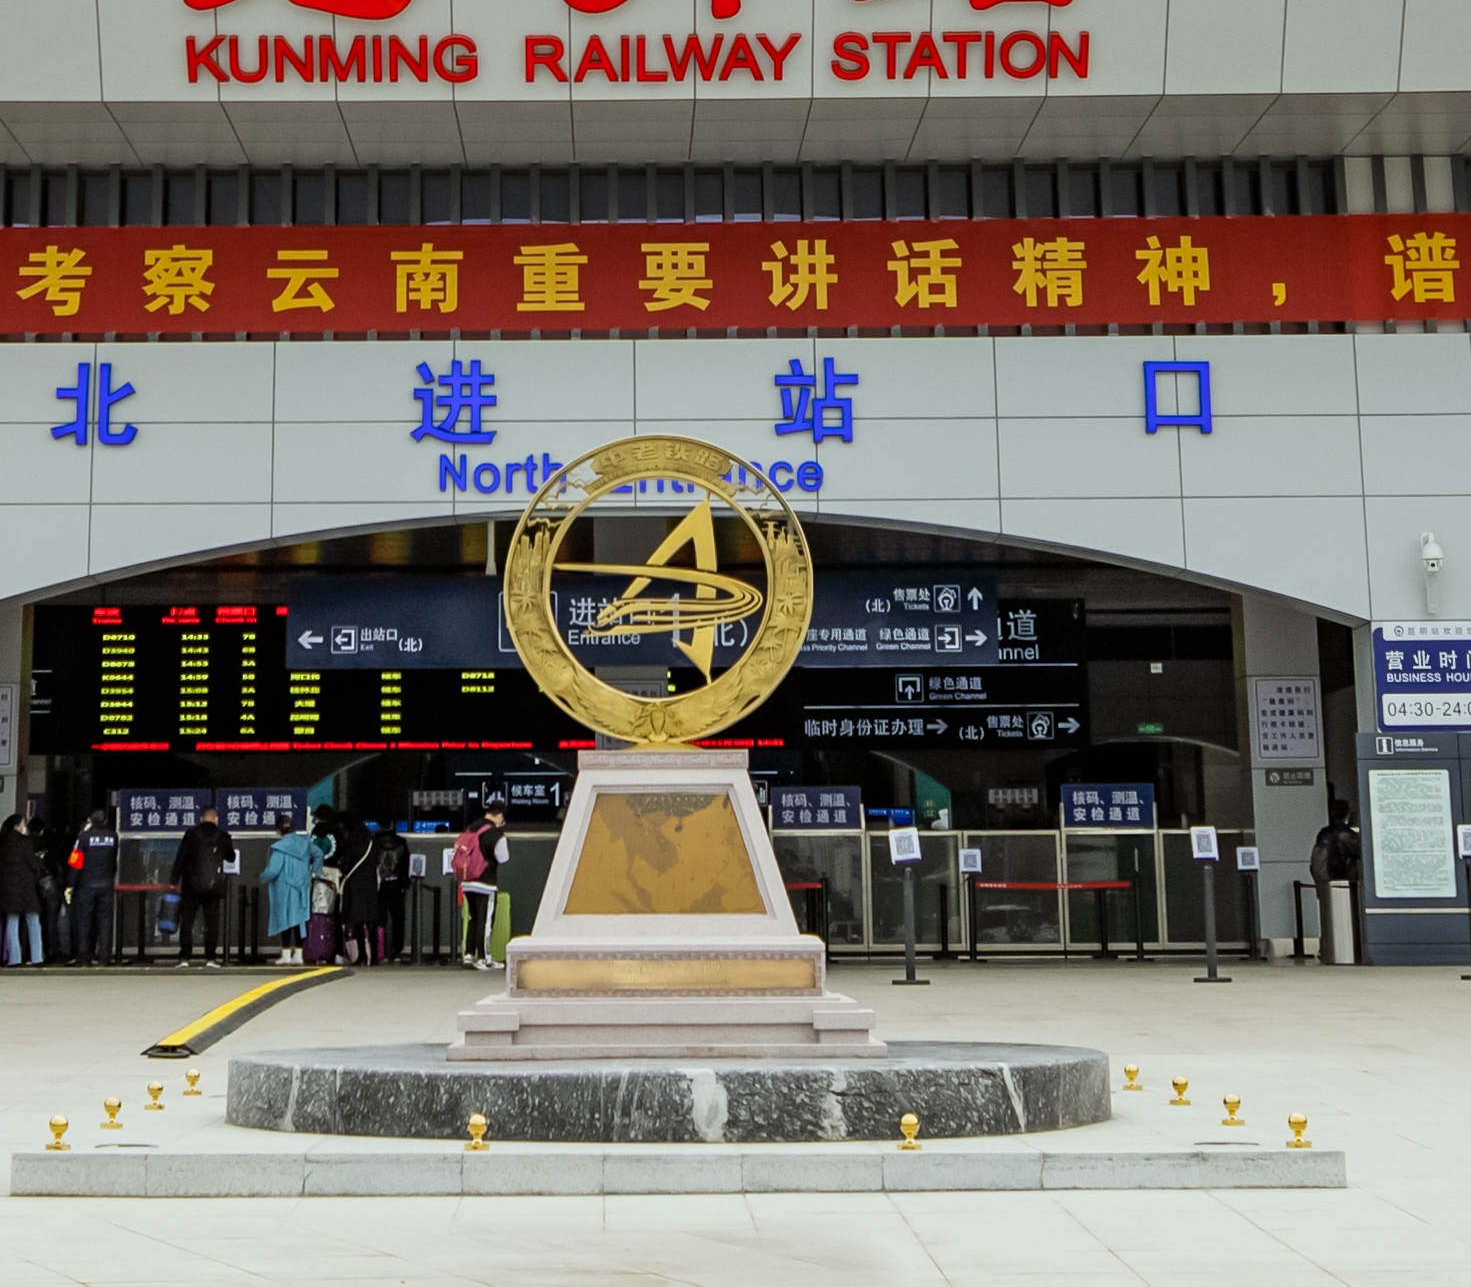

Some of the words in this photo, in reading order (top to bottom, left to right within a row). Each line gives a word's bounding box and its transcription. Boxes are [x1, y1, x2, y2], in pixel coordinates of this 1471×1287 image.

[185, 31, 479, 83] KUNMING
[524, 31, 803, 83] RAILWAY
[829, 30, 1091, 81] STATION
[50, 355, 1214, 447] 北进站口
[599, 442, 724, 471] 中老铁路
[893, 587, 930, 602] 售票处
[904, 602, 930, 610] Tickets
[360, 628, 398, 643] 出站口
[879, 628, 930, 642] 绿色通道
[811, 643, 837, 653] Priority
[838, 643, 868, 651] Channel
[876, 642, 899, 651] Green
[900, 642, 931, 651] Channel
[929, 676, 983, 691] 绿色通道
[1386, 672, 1442, 683] BUSINESS
[929, 692, 954, 701] Green
[955, 691, 987, 700] Channel
[241, 714, 255, 722] 4A
[804, 718, 925, 737] 临时身份证办理
[986, 715, 1024, 729] 售票处
[997, 729, 1023, 737] Tickets
[1395, 738, 1424, 747] 信息服务
[511, 784, 546, 797] 候车室
[550, 782, 560, 807] 1
[781, 793, 851, 807] 核码、测温、
[1072, 791, 1144, 806] 核码、测温、
[130, 796, 201, 810] 核码、测温、
[227, 795, 299, 809] 核码、测温、
[130, 812, 195, 826] 安检通道
[781, 809, 848, 824] 安检通道
[1073, 807, 1141, 822] 安检通道
